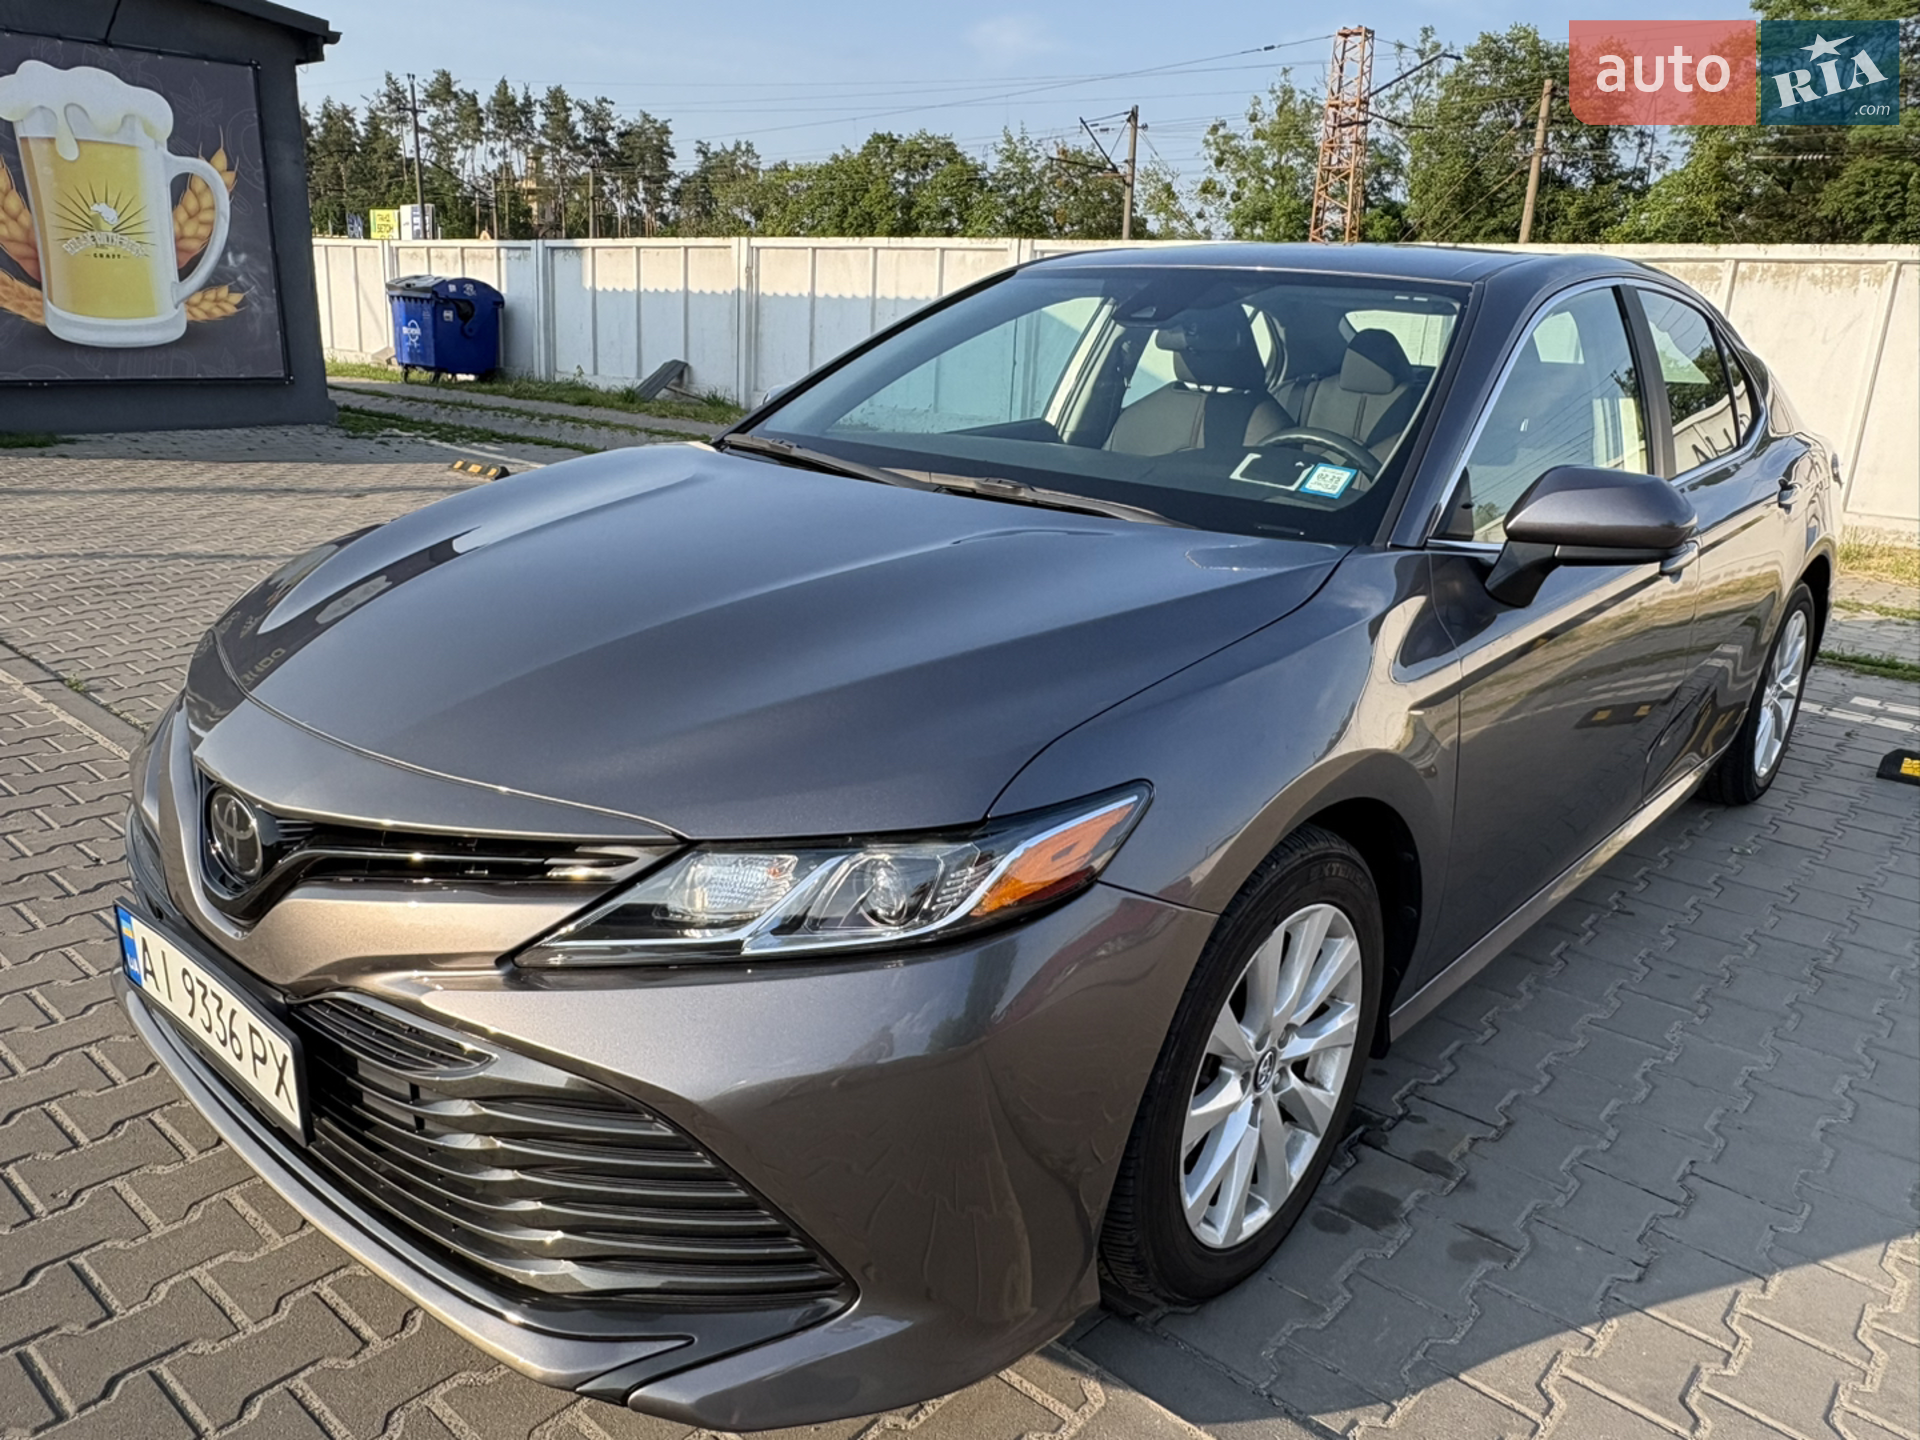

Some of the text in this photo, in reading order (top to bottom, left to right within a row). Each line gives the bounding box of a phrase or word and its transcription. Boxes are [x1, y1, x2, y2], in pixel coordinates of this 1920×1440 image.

[128, 955, 139, 972] UA
[141, 936, 296, 1113] AI 9336 PX
